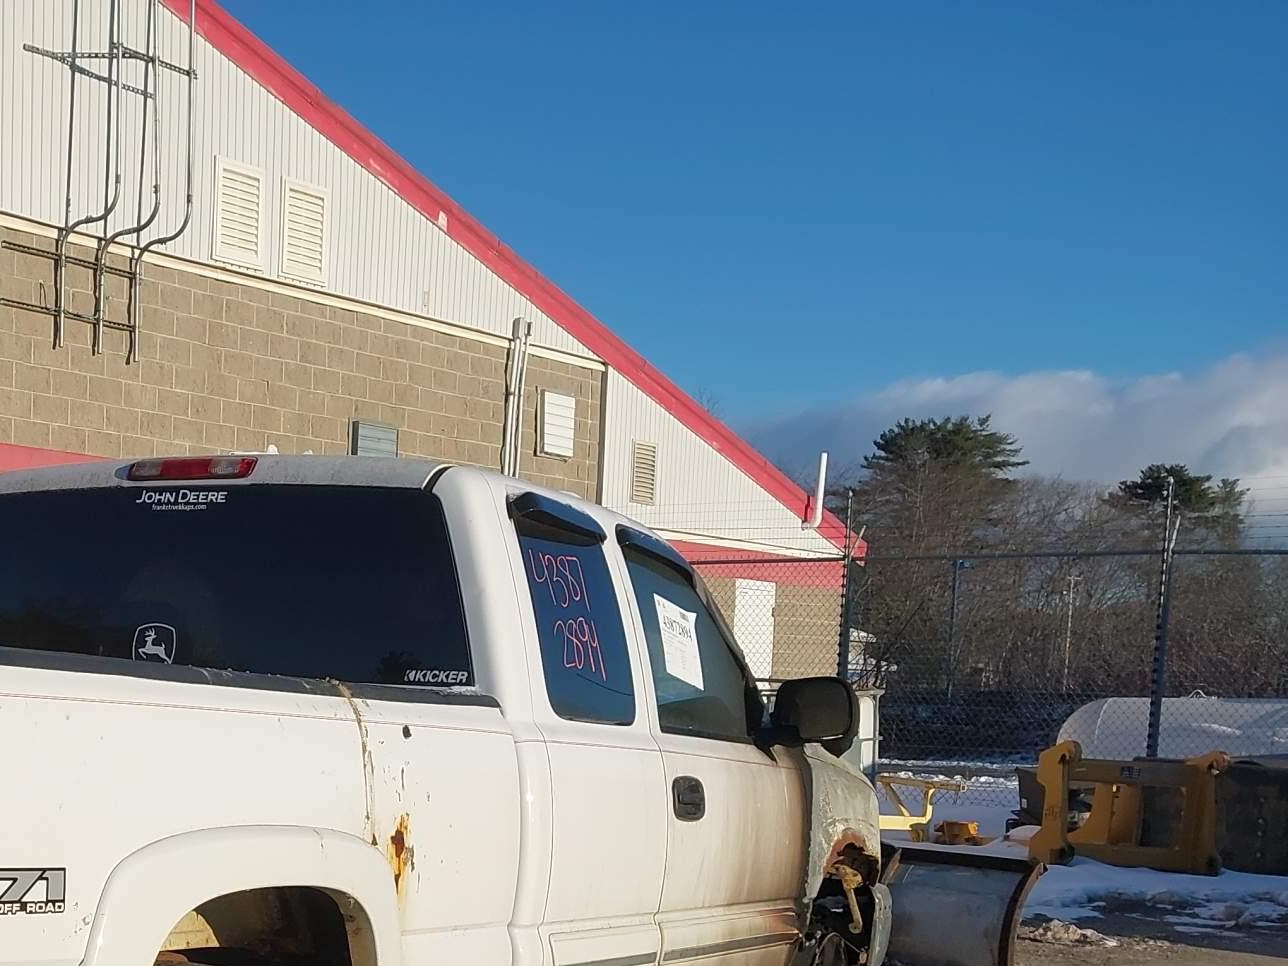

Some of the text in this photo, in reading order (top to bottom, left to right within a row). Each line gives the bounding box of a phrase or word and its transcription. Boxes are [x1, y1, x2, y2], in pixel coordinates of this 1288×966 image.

[136, 489, 228, 503] JOHN DEERE
[528, 548, 591, 613] 4387
[553, 617, 607, 681] 2894
[415, 669, 469, 683] KICKER
[25, 902, 65, 914] ROAD
